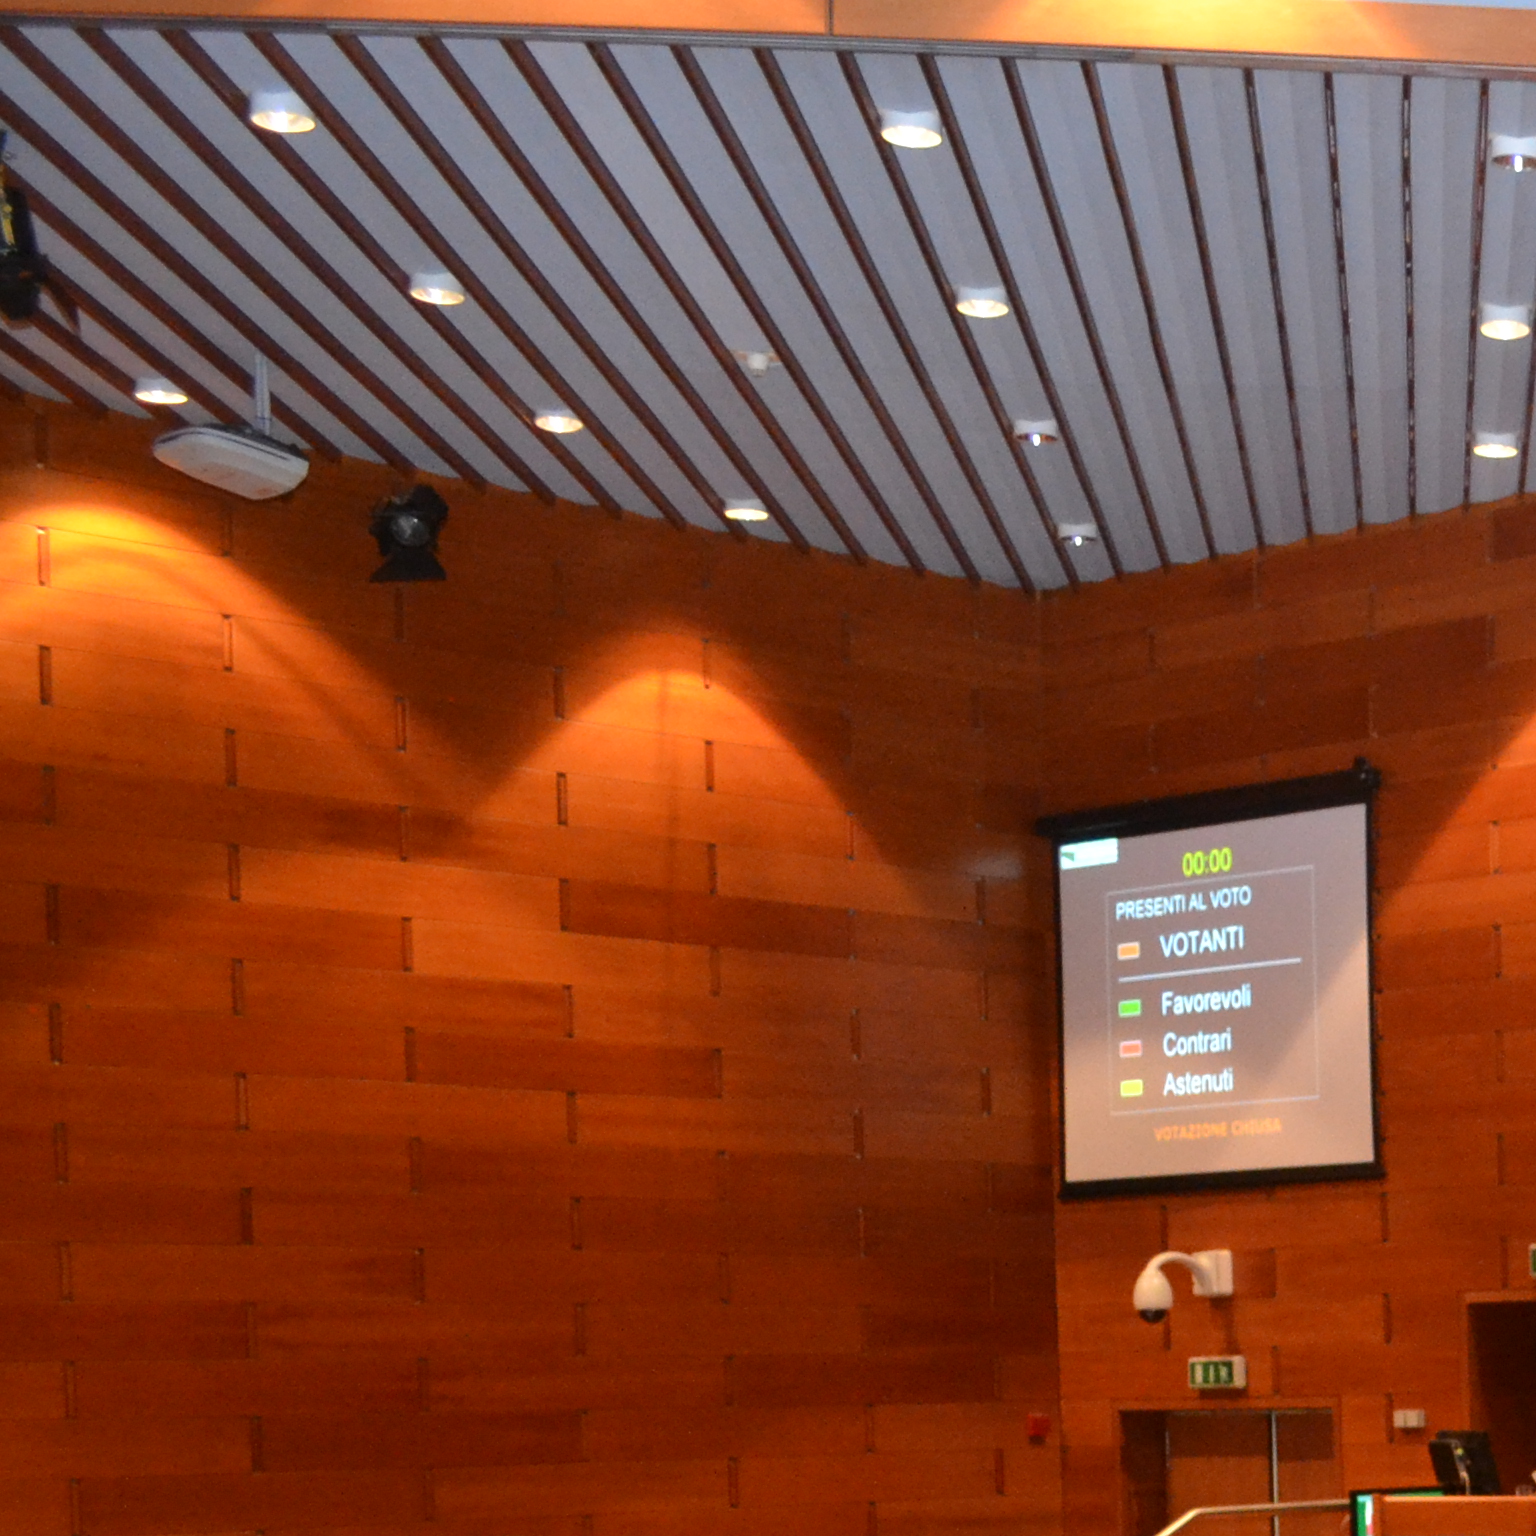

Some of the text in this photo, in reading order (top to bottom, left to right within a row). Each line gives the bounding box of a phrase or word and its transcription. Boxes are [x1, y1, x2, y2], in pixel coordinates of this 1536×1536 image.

[1182, 847, 1232, 877] 00:00
[1115, 885, 1252, 920] PRESENTI AL VOTO
[1159, 925, 1245, 958] VOTANTI
[1161, 983, 1252, 1017] Favorevoli
[1163, 1027, 1232, 1057] Contrari
[1163, 1067, 1234, 1097] Astenuti
[1153, 1121, 1228, 1141] VOTAZIONE
